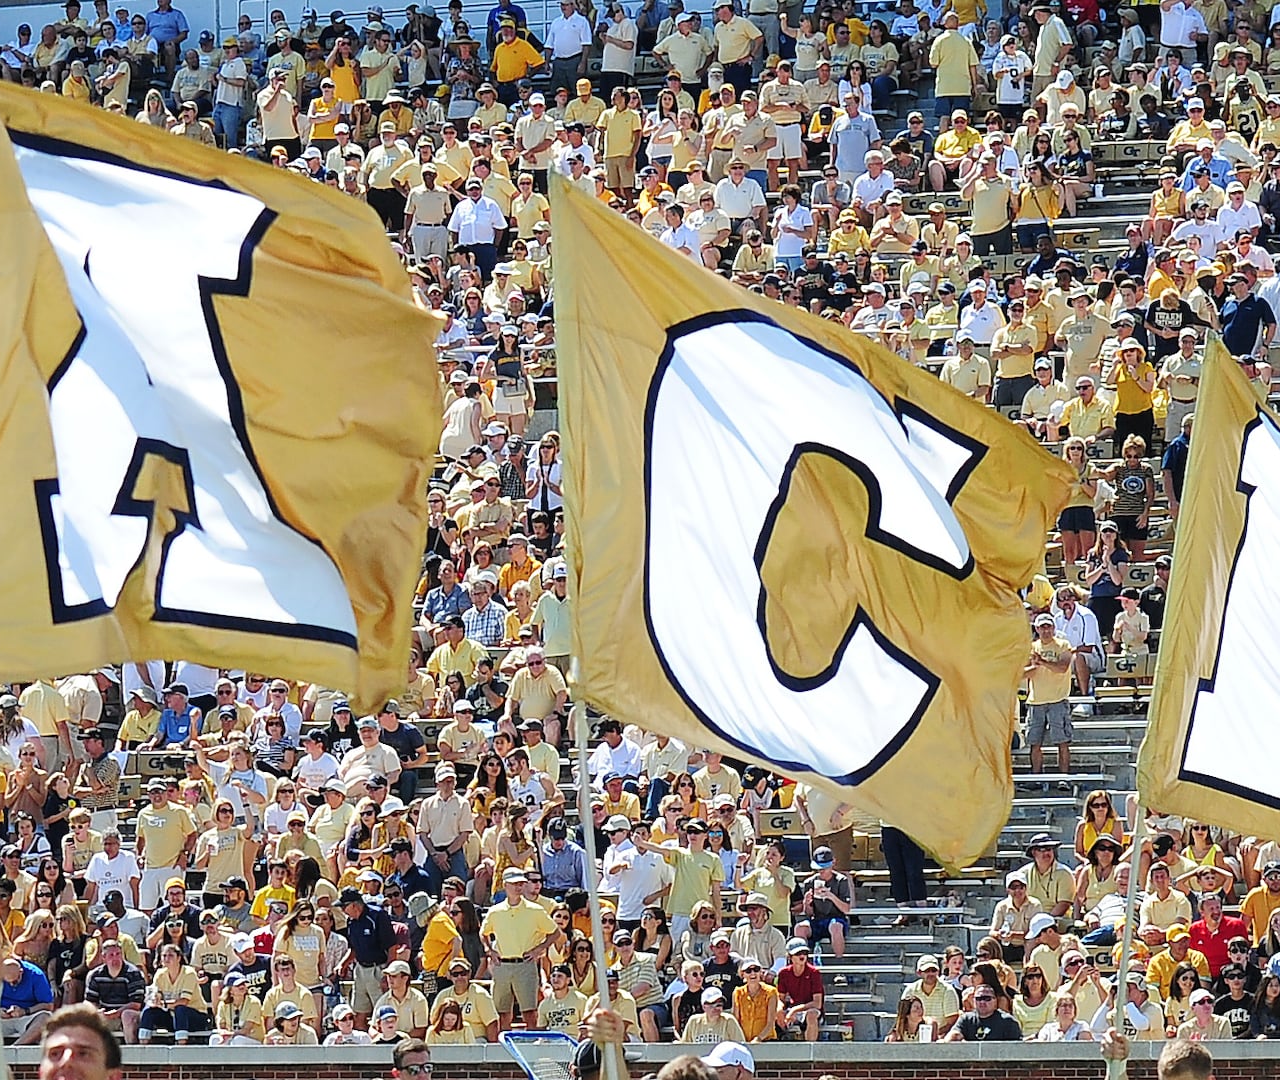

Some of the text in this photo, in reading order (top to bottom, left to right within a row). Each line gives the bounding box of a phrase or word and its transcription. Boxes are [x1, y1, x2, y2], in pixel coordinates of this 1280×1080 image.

[1124, 147, 1141, 156] GT
[910, 199, 926, 208] GT
[946, 198, 962, 207] GT
[1073, 235, 1090, 244] GT
[1091, 255, 1108, 264] GT
[5, 127, 360, 652] A
[644, 308, 988, 786] C
[1129, 569, 1149, 581] GT
[149, 758, 167, 769] GT
[148, 816, 166, 827] GT
[771, 817, 791, 830] GT
